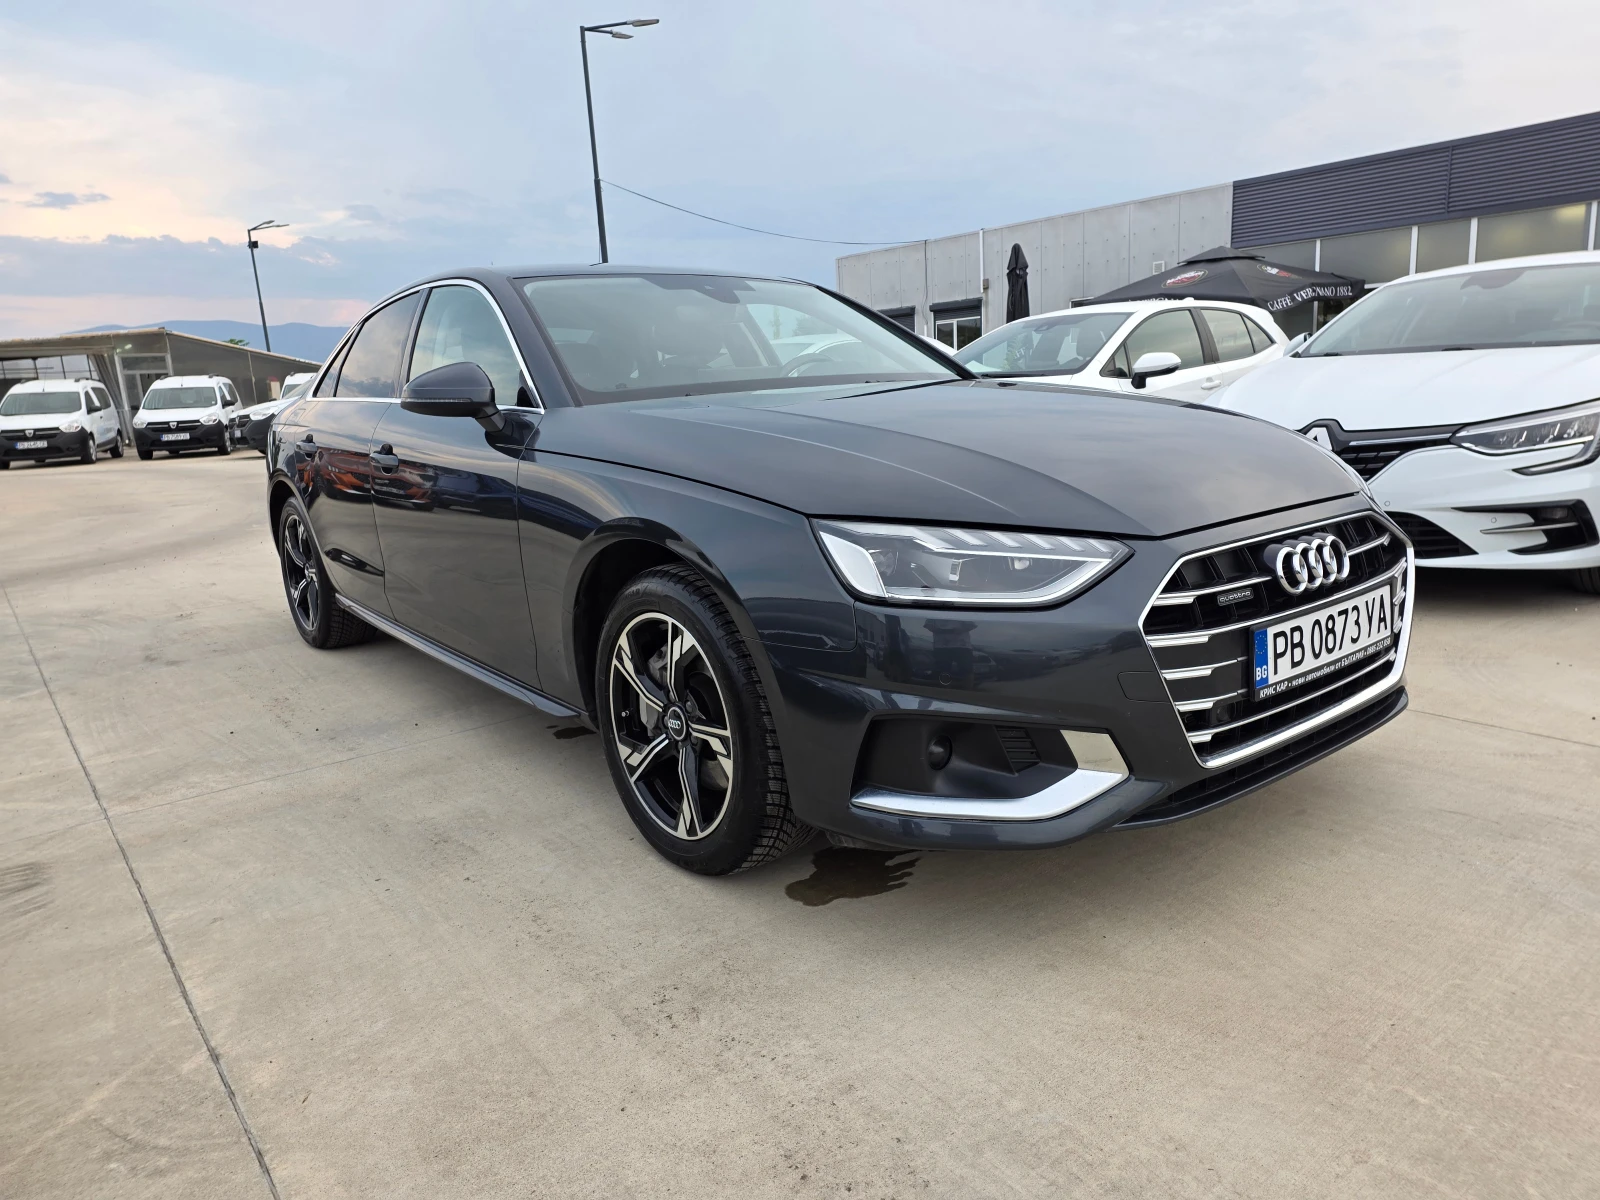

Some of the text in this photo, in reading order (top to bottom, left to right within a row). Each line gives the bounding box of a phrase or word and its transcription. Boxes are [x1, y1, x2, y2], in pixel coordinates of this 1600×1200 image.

[1336, 285, 1353, 297] 1882
[1219, 591, 1251, 603] quattro
[1272, 593, 1388, 676] PB 0873 YA
[1255, 665, 1268, 681] BG
[1259, 685, 1276, 698] КРИС
[1276, 681, 1288, 692] КАР
